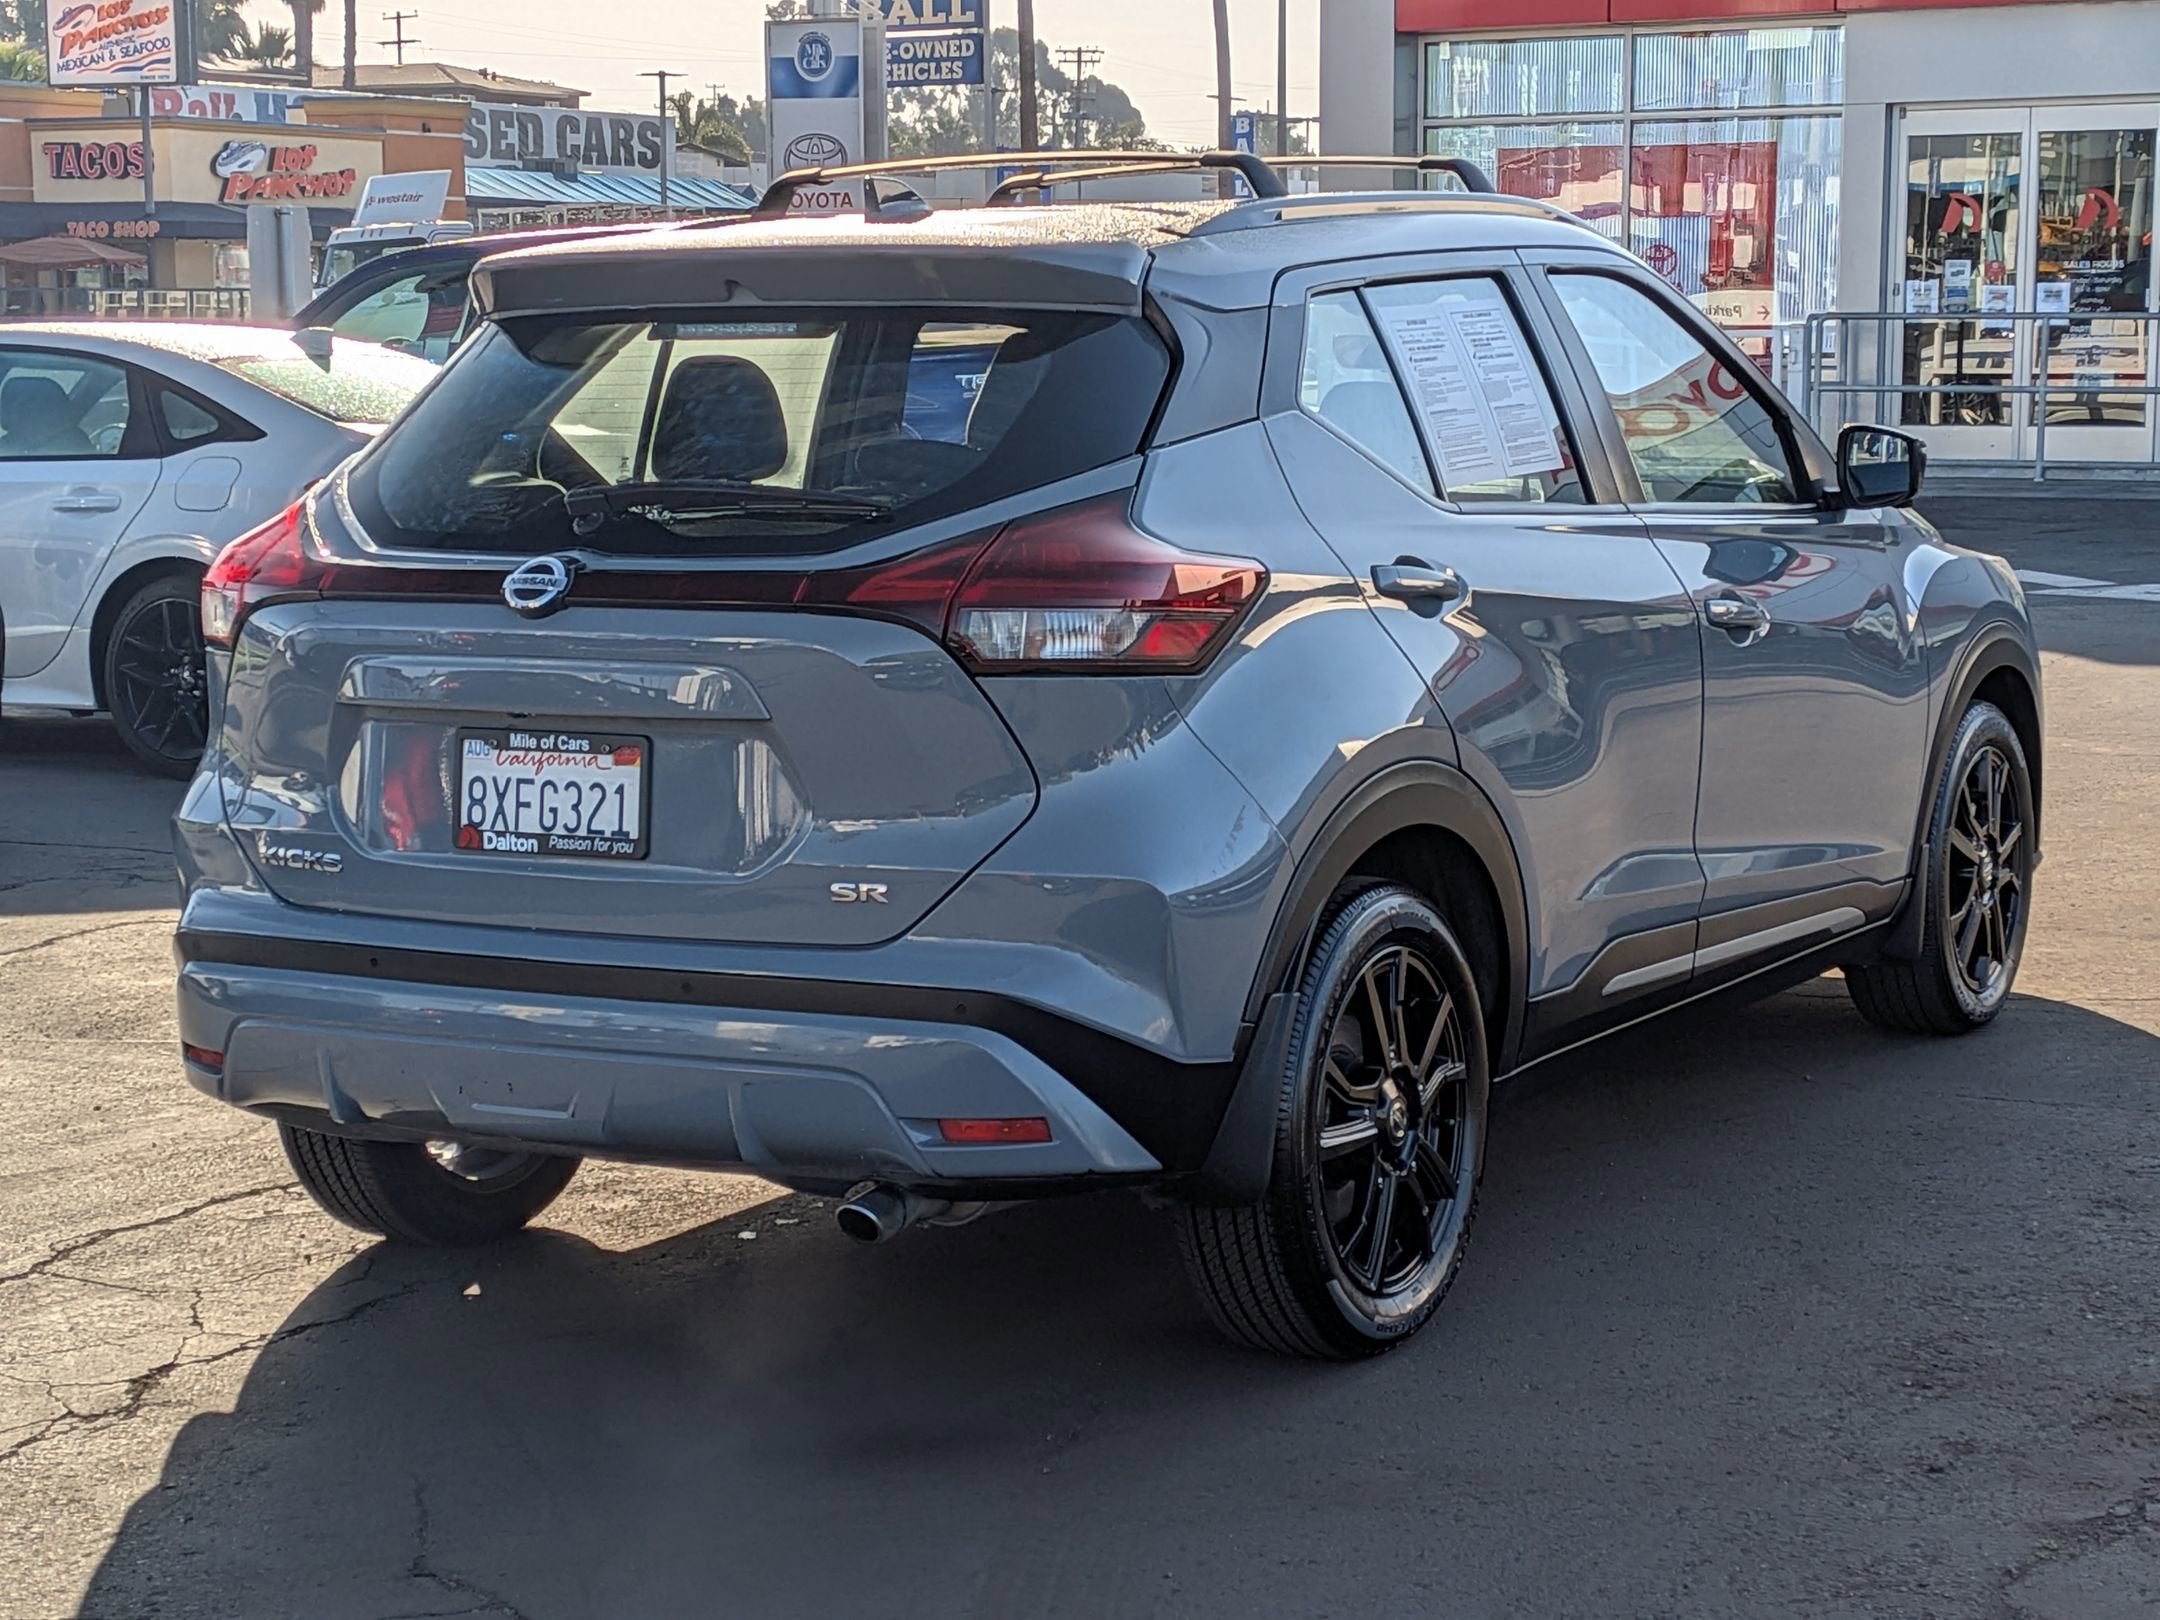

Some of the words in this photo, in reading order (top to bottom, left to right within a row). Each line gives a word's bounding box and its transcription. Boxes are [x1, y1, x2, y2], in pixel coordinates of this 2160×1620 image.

[97, 0, 134, 22] LOS
[56, 51, 105, 73] MEXICAN
[108, 49, 116, 61] &
[120, 37, 171, 59] SEAFOOD
[885, 39, 976, 60] E-OWNED
[885, 61, 963, 81] EHICLES
[464, 108, 544, 164] SED
[556, 114, 661, 169] CARS
[43, 142, 147, 178] TACOS
[271, 144, 318, 173] LOS
[789, 191, 854, 209] OYOTA
[67, 220, 110, 239] TACO
[113, 220, 161, 238] SHOP
[510, 577, 558, 587] NISSAN
[509, 732, 537, 748] Mile
[540, 734, 555, 749] of
[556, 736, 590, 751] Cars
[496, 749, 612, 777] California
[466, 775, 631, 840] 8XFG321
[482, 831, 539, 853] Dalton
[549, 835, 592, 851] Passion
[592, 837, 612, 852] for
[610, 840, 635, 855] you
[258, 845, 343, 873] KICKS
[829, 882, 889, 904] SR
